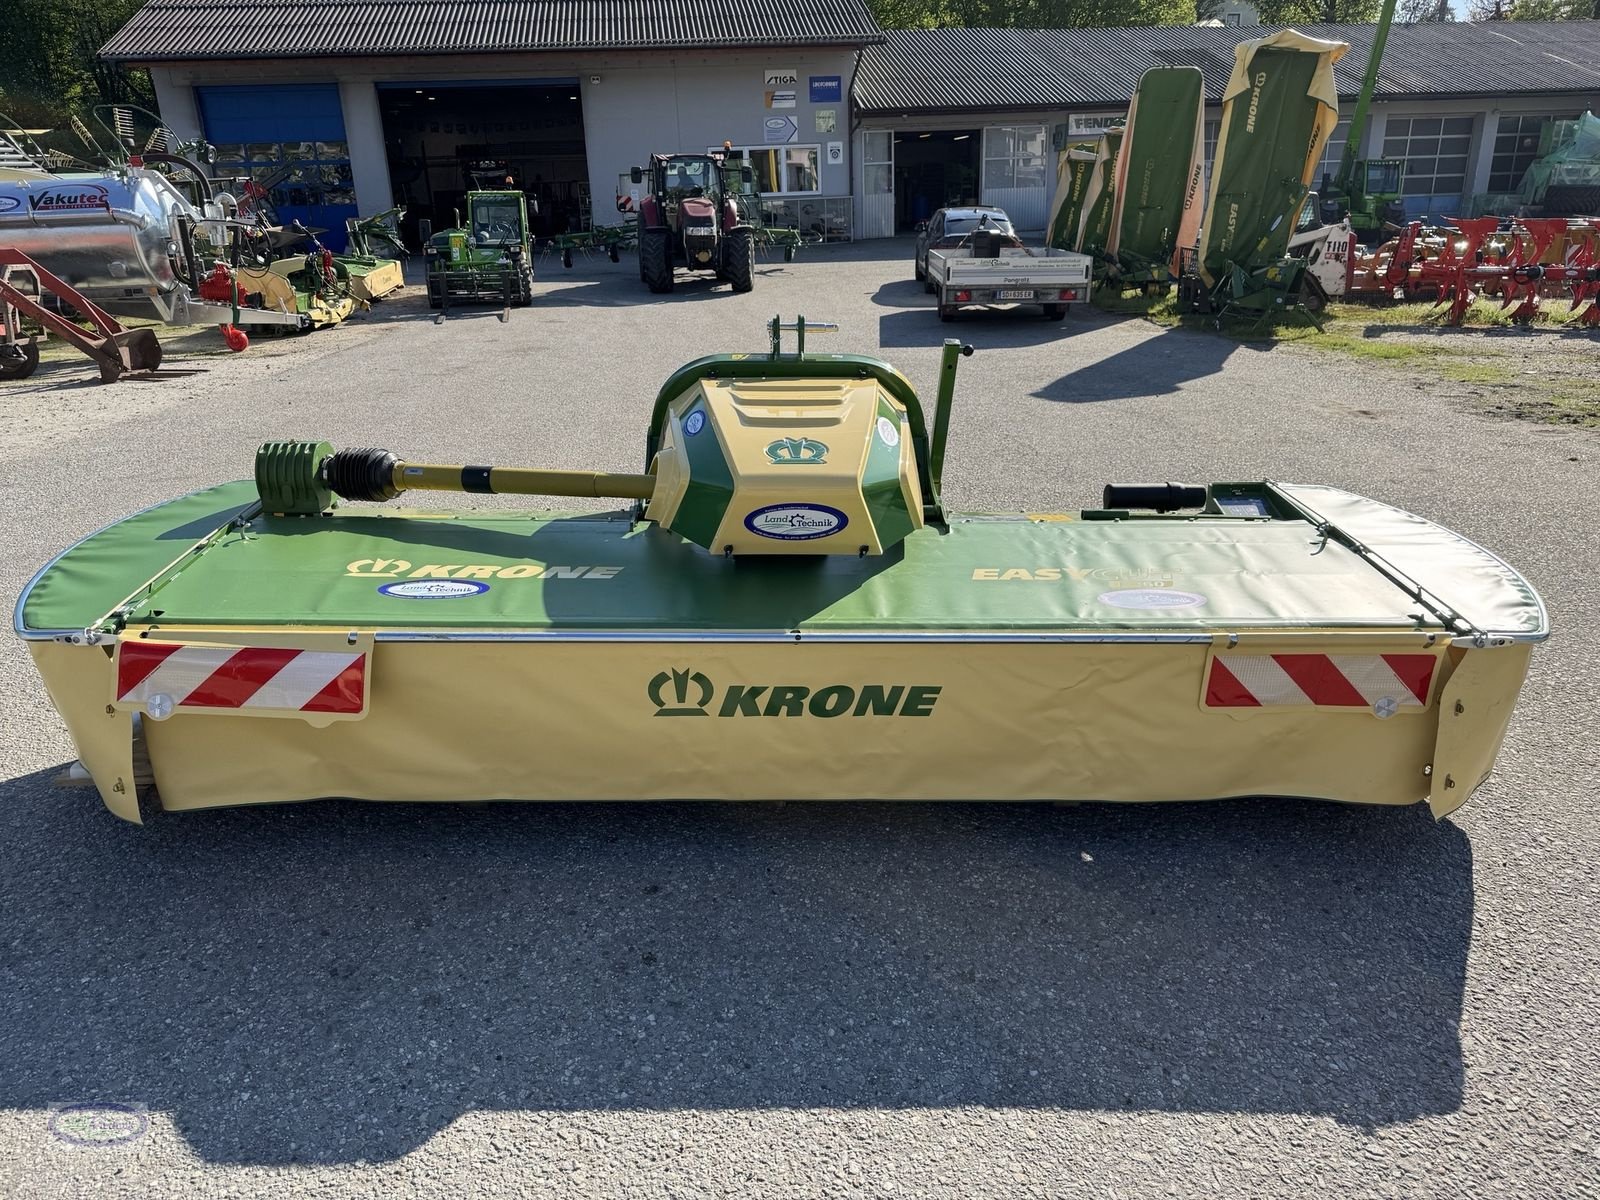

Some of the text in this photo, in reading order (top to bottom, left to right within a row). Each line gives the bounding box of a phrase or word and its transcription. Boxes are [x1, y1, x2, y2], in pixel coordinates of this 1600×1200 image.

[767, 76, 797, 84] STIGA
[1246, 87, 1260, 134] KRONE
[1074, 116, 1117, 129] FEND
[1073, 169, 1083, 202] KRONE
[1189, 163, 1202, 200] KRONE
[28, 191, 109, 211] Vakutec
[1327, 241, 1348, 252] T110
[764, 515, 833, 527] Land Technik
[407, 564, 625, 580] KRONE
[718, 685, 943, 718] KRONE
